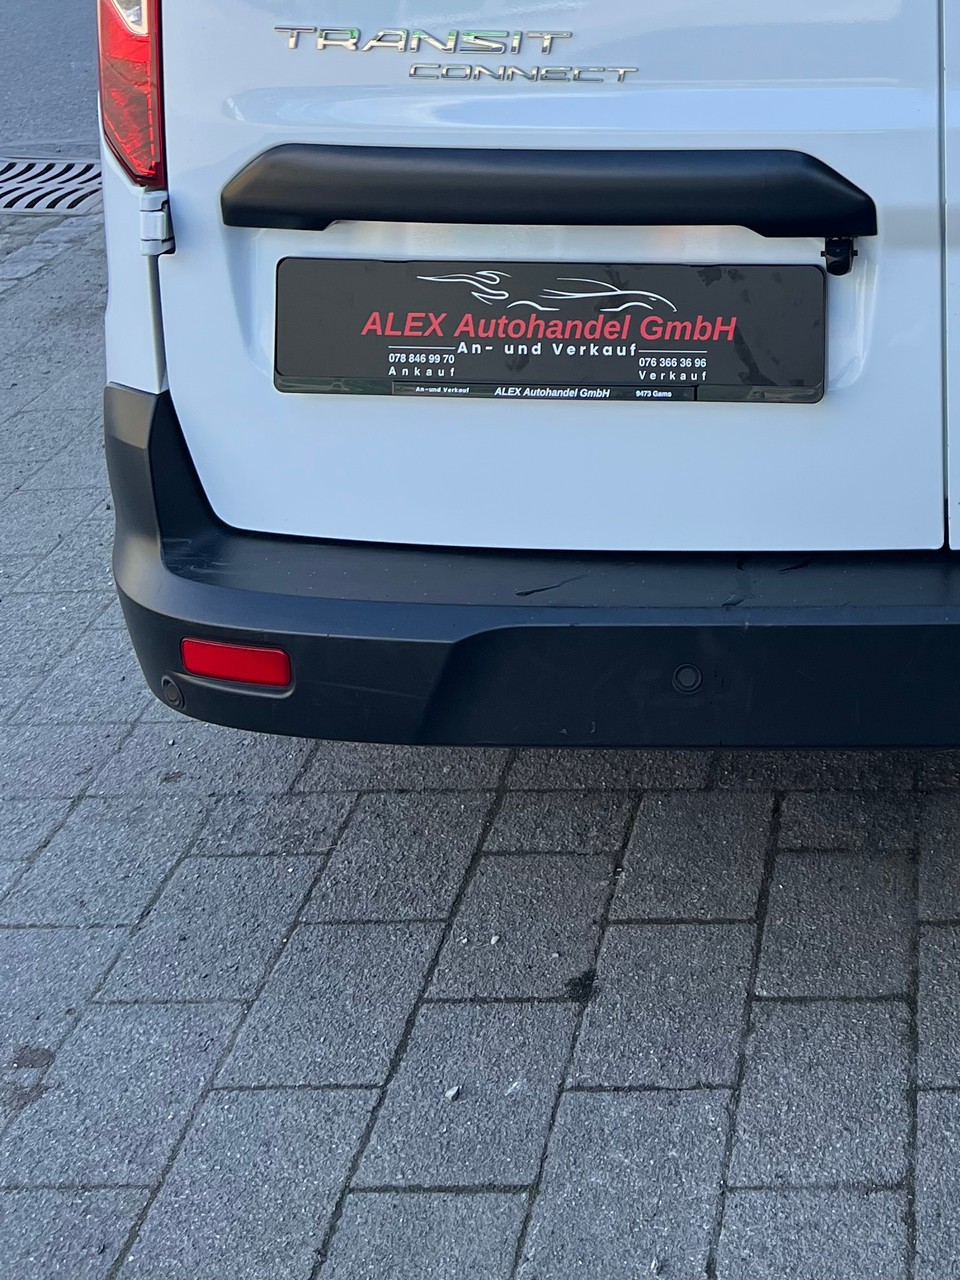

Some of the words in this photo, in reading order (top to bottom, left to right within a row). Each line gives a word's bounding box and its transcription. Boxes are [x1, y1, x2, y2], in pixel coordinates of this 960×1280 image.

[273, 25, 573, 55] TRANSIT
[408, 63, 639, 83] CONNECT
[360, 311, 448, 337] ALEX
[453, 313, 632, 341] Autohandel
[639, 315, 737, 341] GmbH
[457, 341, 494, 355] An-
[504, 342, 542, 355] und
[552, 343, 637, 356] Verkauf
[388, 353, 408, 363] 078
[408, 354, 427, 364] 846
[428, 354, 441, 364] 99
[442, 355, 455, 364] 70
[638, 357, 657, 367] 076
[659, 358, 678, 368] 366
[679, 358, 692, 368] 36
[694, 358, 707, 368] 96
[388, 366, 455, 377] Ankauf
[638, 371, 707, 381] Verkauf
[442, 386, 470, 394] Verkauf
[494, 387, 522, 396] ALEX
[522, 387, 579, 398] Autohandel
[579, 388, 611, 398] GmbH
[635, 390, 652, 398] 9473
[652, 390, 672, 398] Gams
